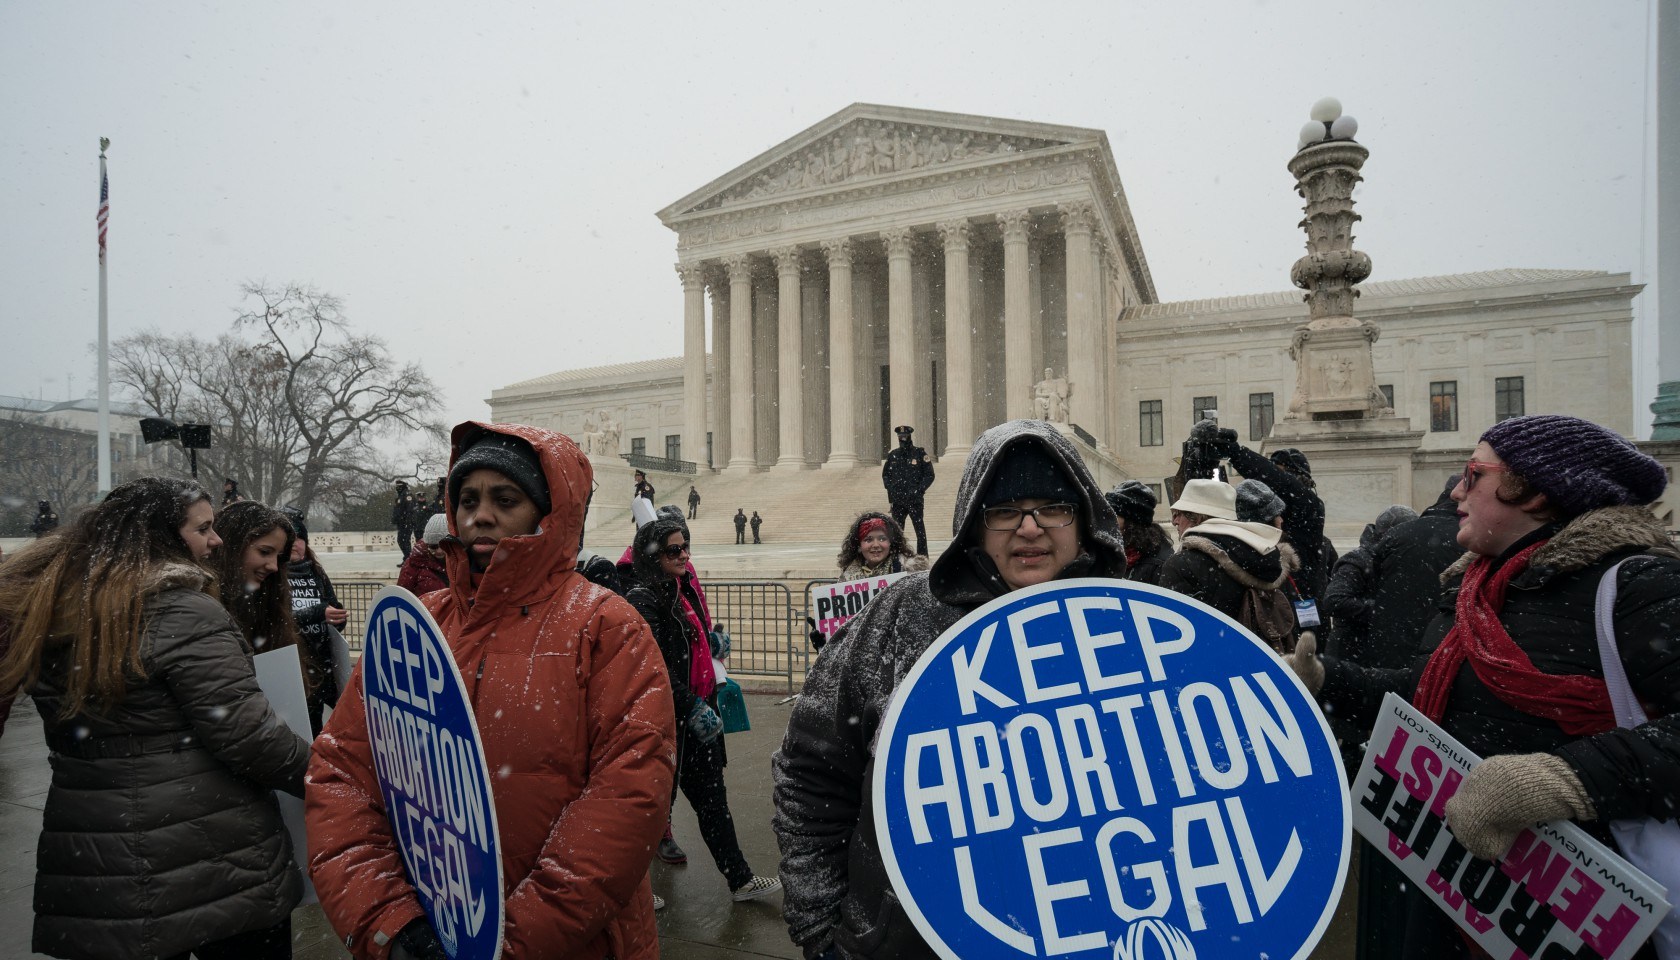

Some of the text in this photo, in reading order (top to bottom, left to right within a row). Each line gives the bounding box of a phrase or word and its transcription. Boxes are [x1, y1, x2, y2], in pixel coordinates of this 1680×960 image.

[308, 578, 316, 586] IS
[831, 579, 888, 596] I AM A
[371, 607, 444, 716] KEEP
[951, 596, 1196, 716] KEEP
[369, 694, 488, 854] ABORTION
[904, 671, 1312, 845] ABORTION
[390, 789, 486, 938] LEGAL
[954, 796, 1303, 957] LEGAL
[1374, 725, 1640, 960] FEMIST
[1388, 830, 1413, 860] A
[1113, 919, 1198, 960] NOW
[1425, 868, 1496, 934] AM
